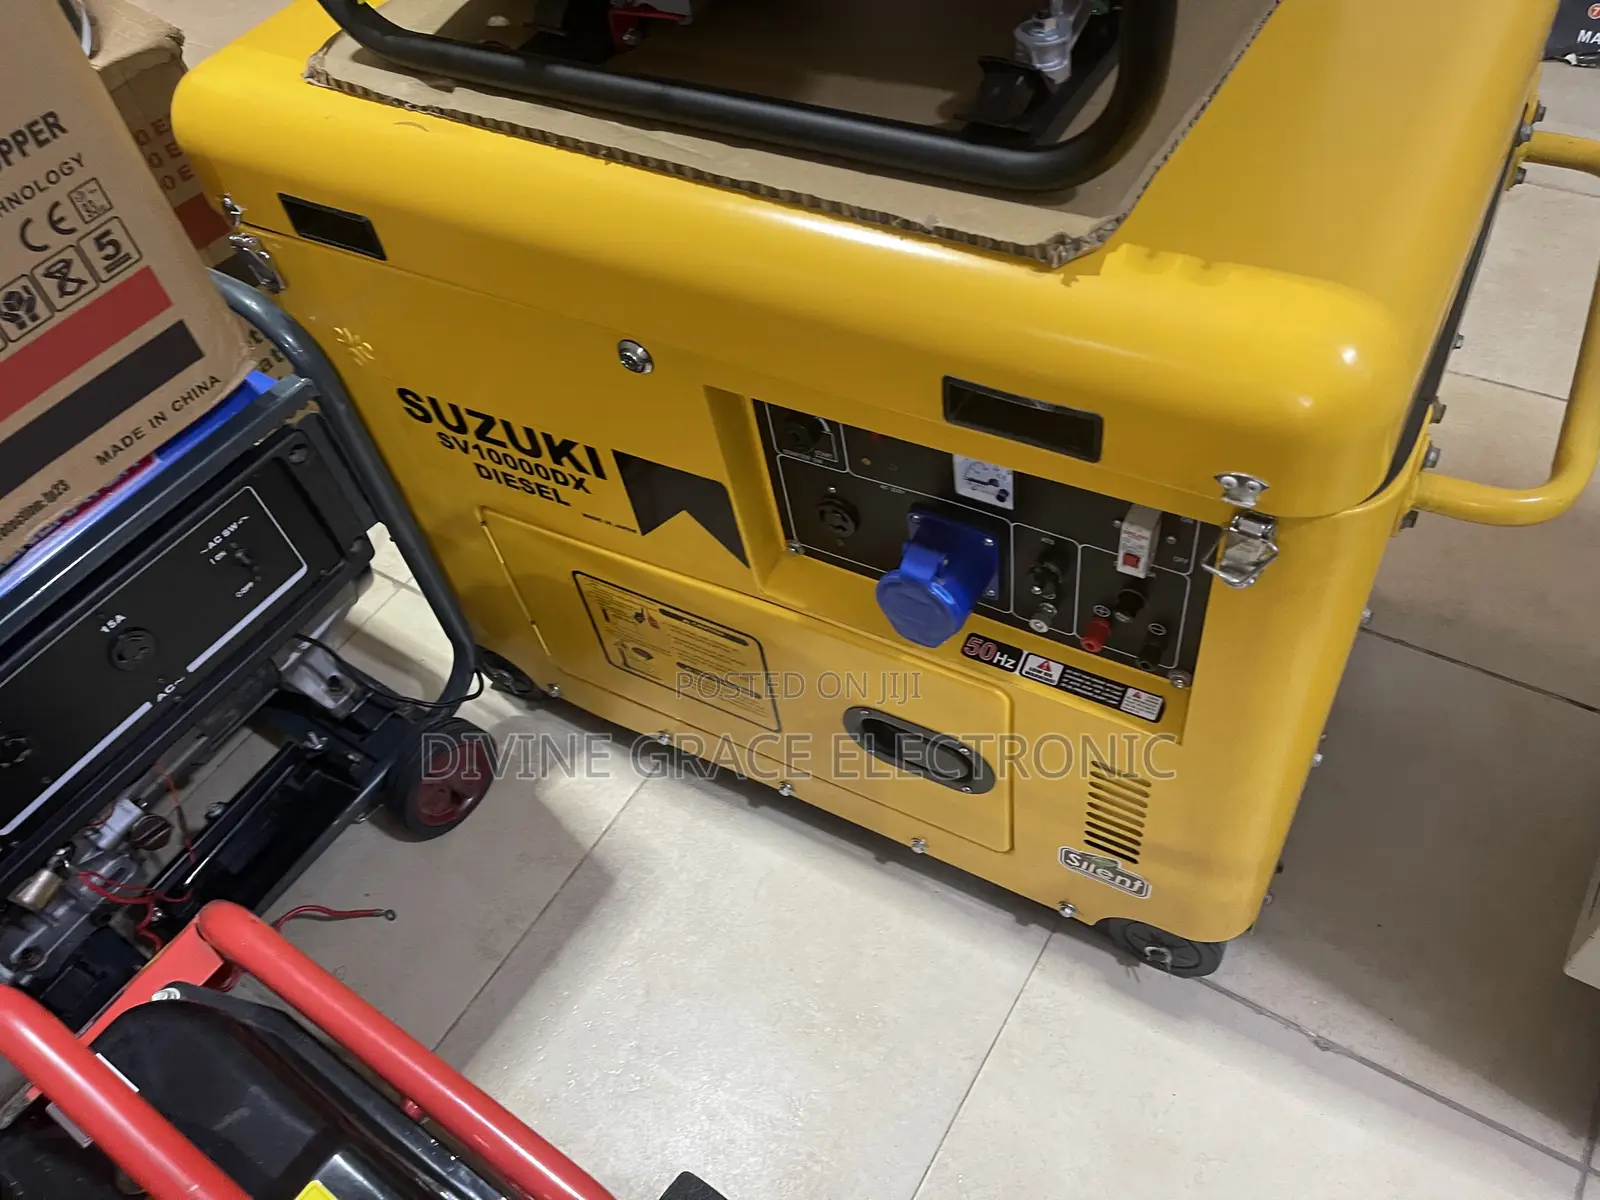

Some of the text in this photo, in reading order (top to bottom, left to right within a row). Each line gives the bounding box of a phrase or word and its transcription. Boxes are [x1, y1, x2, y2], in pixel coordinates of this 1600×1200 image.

[0, 110, 68, 173] PPER
[94, 375, 222, 465] MADE IN CHINA
[396, 387, 607, 480] SUZUKI
[437, 431, 592, 494] SV10000DX
[473, 462, 571, 506] DIESEL
[207, 535, 223, 550] AC
[963, 636, 1017, 671] 50Hz
[1066, 853, 1143, 892] Silent
